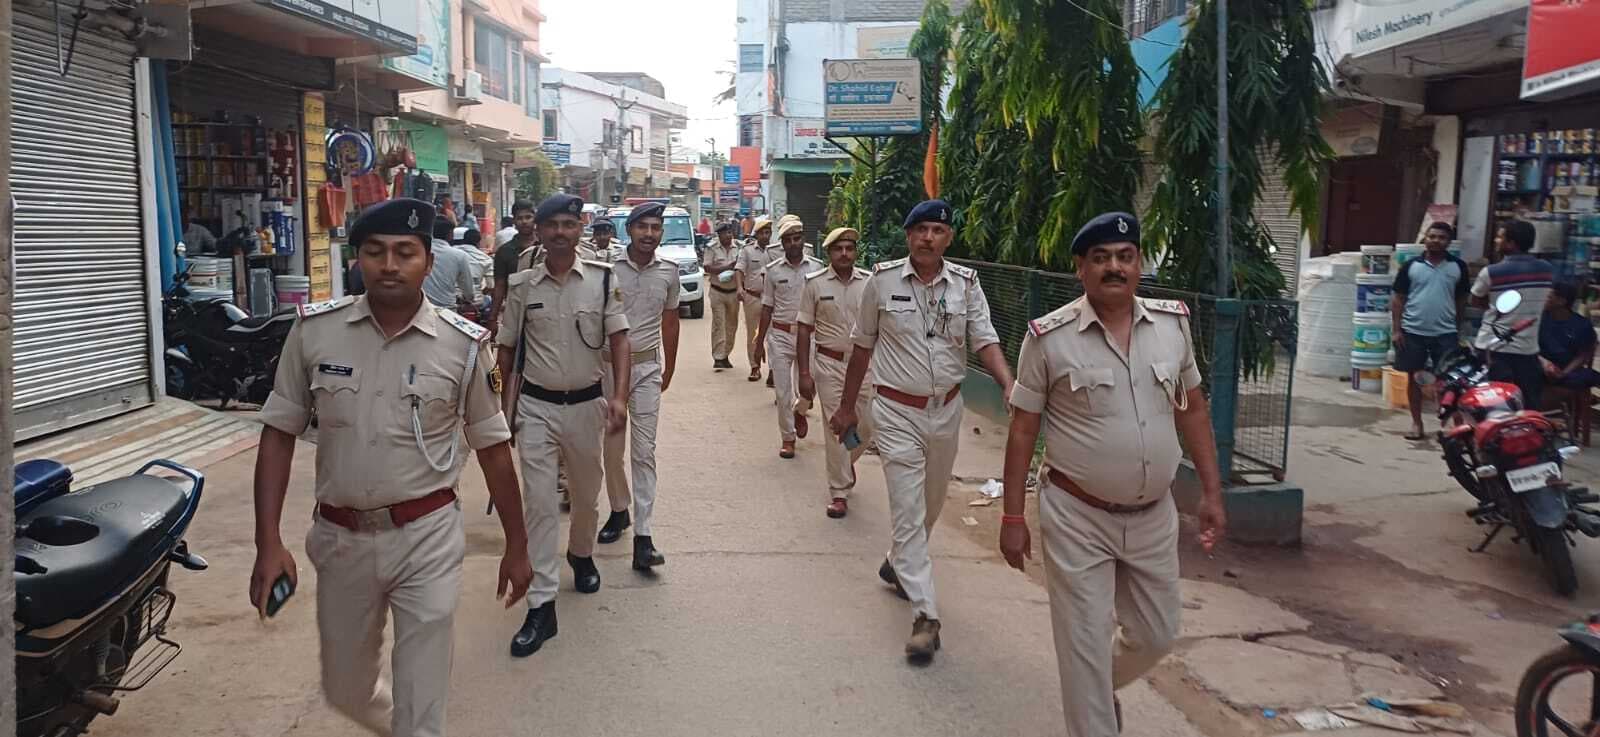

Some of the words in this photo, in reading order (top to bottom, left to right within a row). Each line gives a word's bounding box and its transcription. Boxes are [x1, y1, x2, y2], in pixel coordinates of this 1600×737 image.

[1356, 23, 1382, 43] Nilesh
[1385, 11, 1432, 33] Machinery
[840, 84, 868, 92] Shahid
